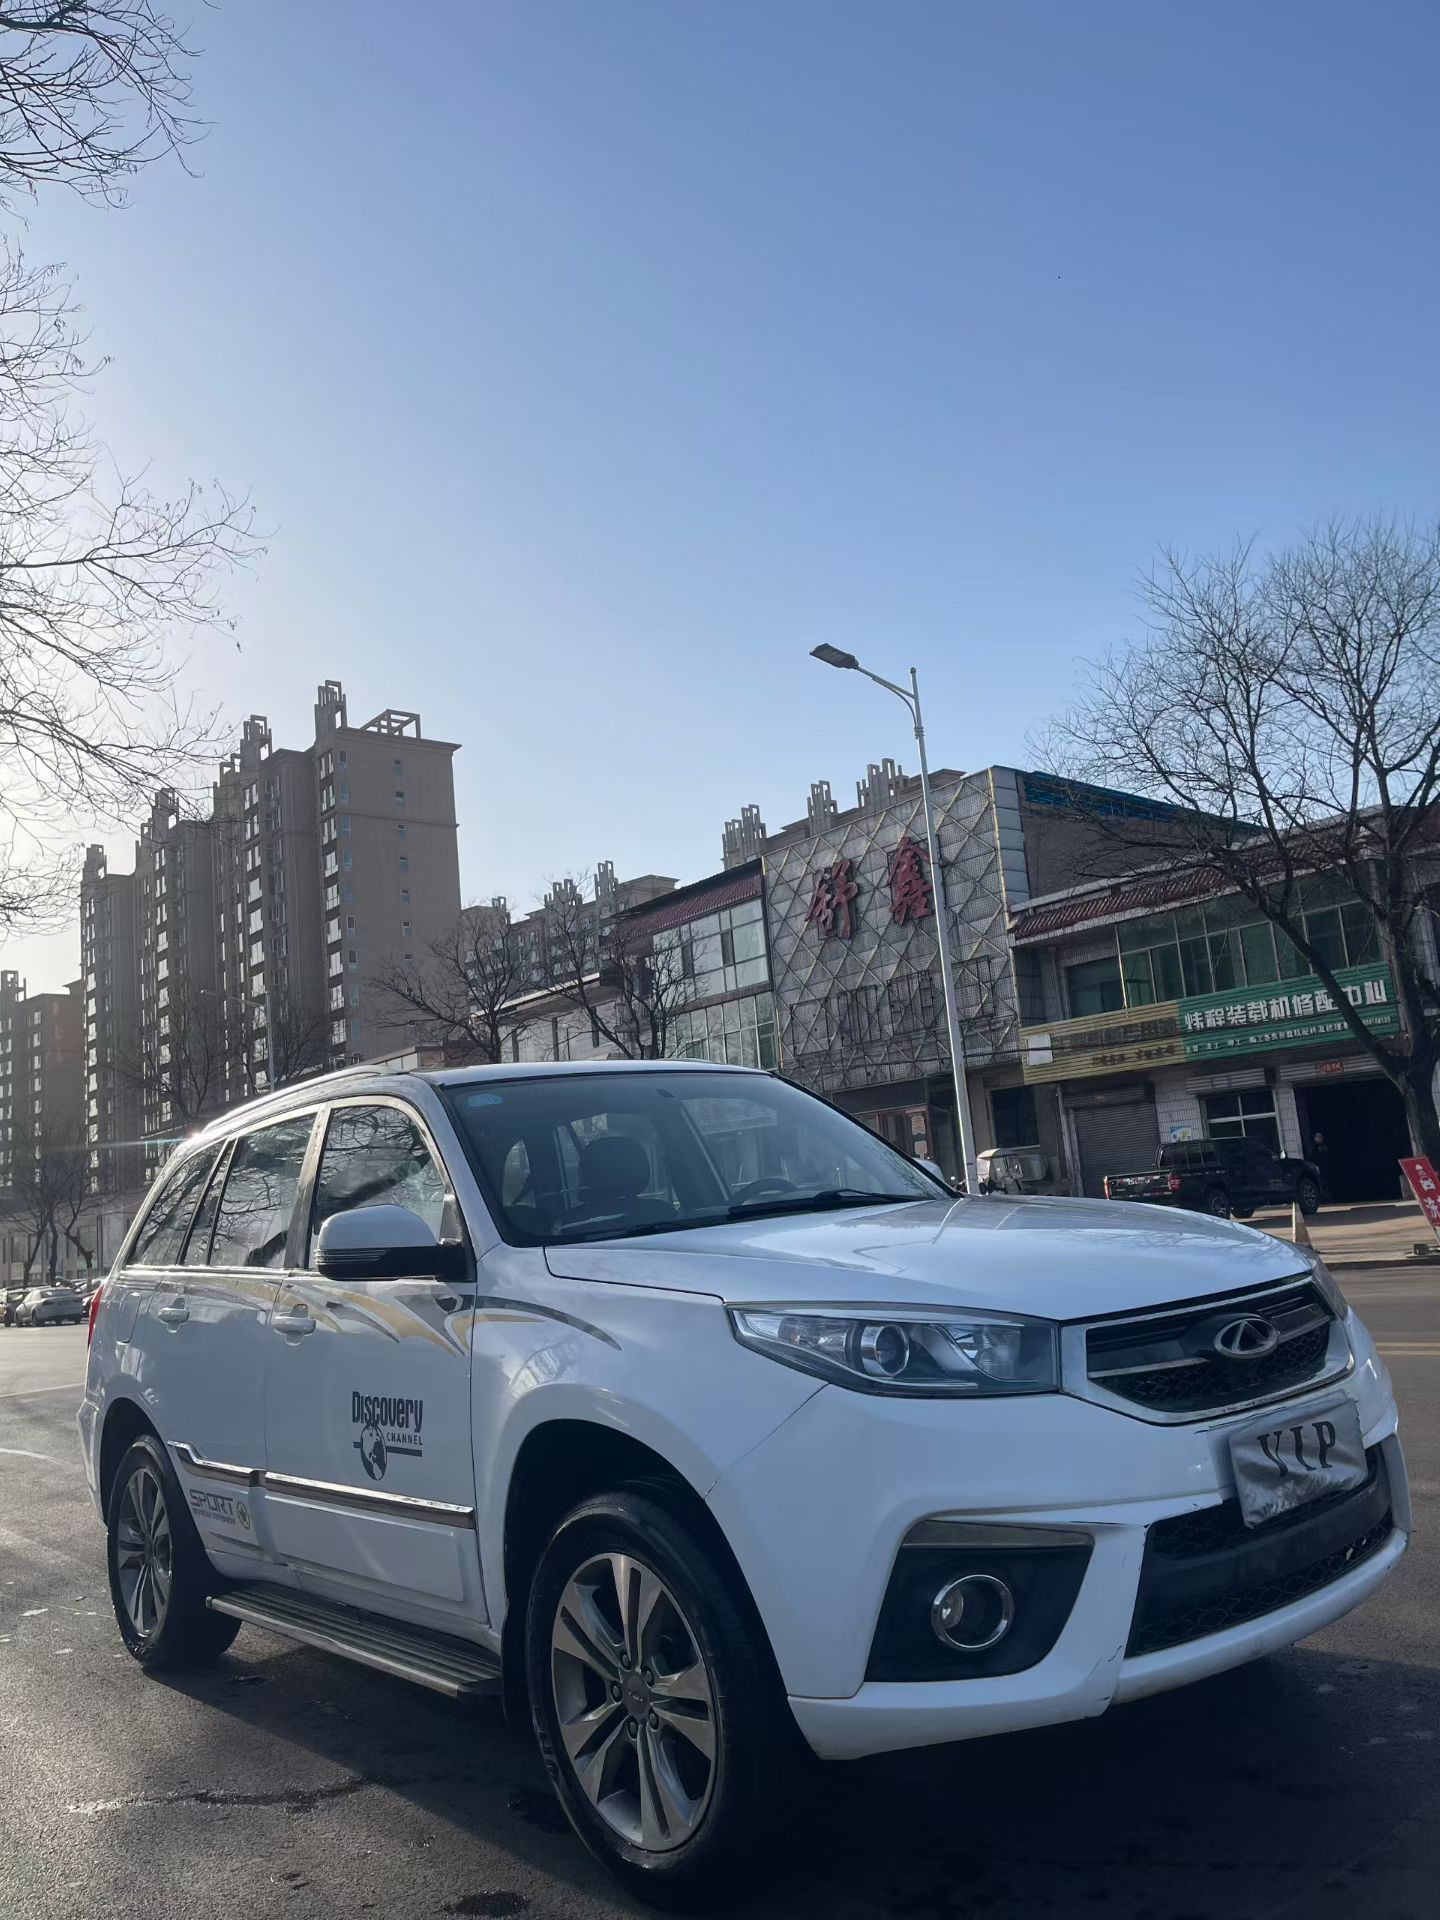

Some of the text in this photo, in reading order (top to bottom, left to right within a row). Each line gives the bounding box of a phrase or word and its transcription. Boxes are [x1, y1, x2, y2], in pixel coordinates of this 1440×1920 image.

[386, 1432, 423, 1445] CHANNEL
[1256, 1421, 1336, 1477] VIP
[190, 1489, 234, 1516] SPORT
